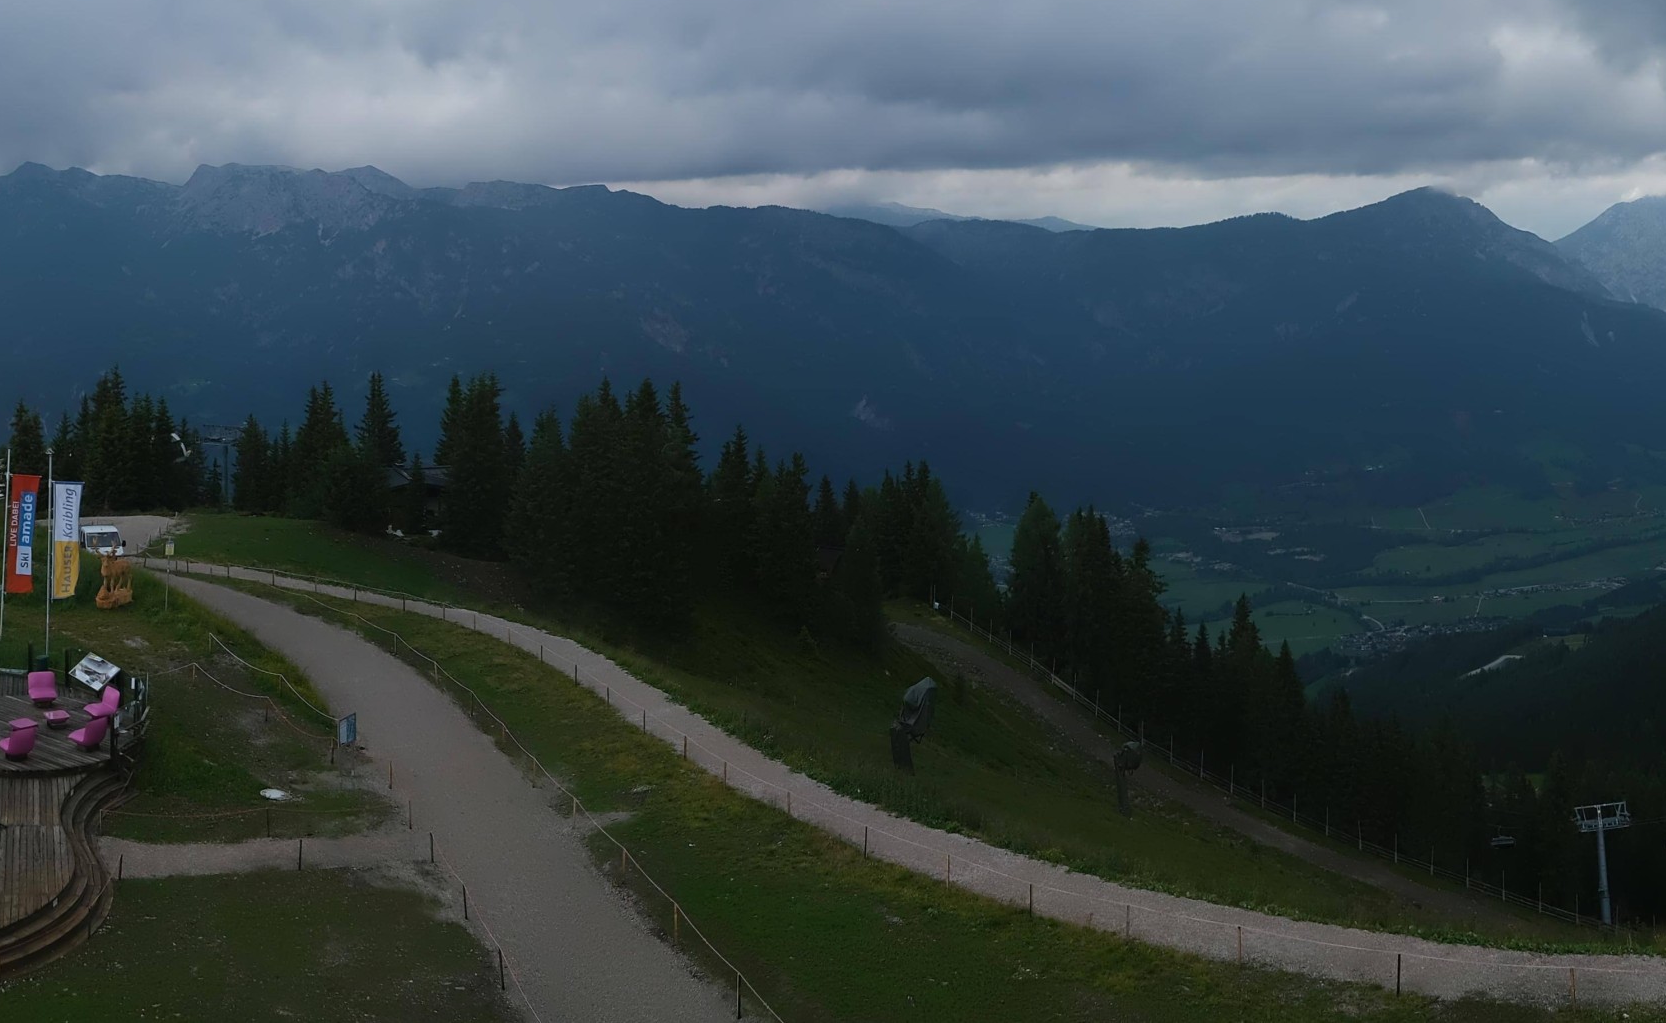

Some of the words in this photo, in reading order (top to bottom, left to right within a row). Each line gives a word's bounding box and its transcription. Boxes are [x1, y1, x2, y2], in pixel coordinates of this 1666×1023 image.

[62, 488, 77, 539] Kaibling
[10, 528, 18, 547] LIVE
[20, 552, 30, 568] Ski
[61, 544, 73, 593] HAUSER
